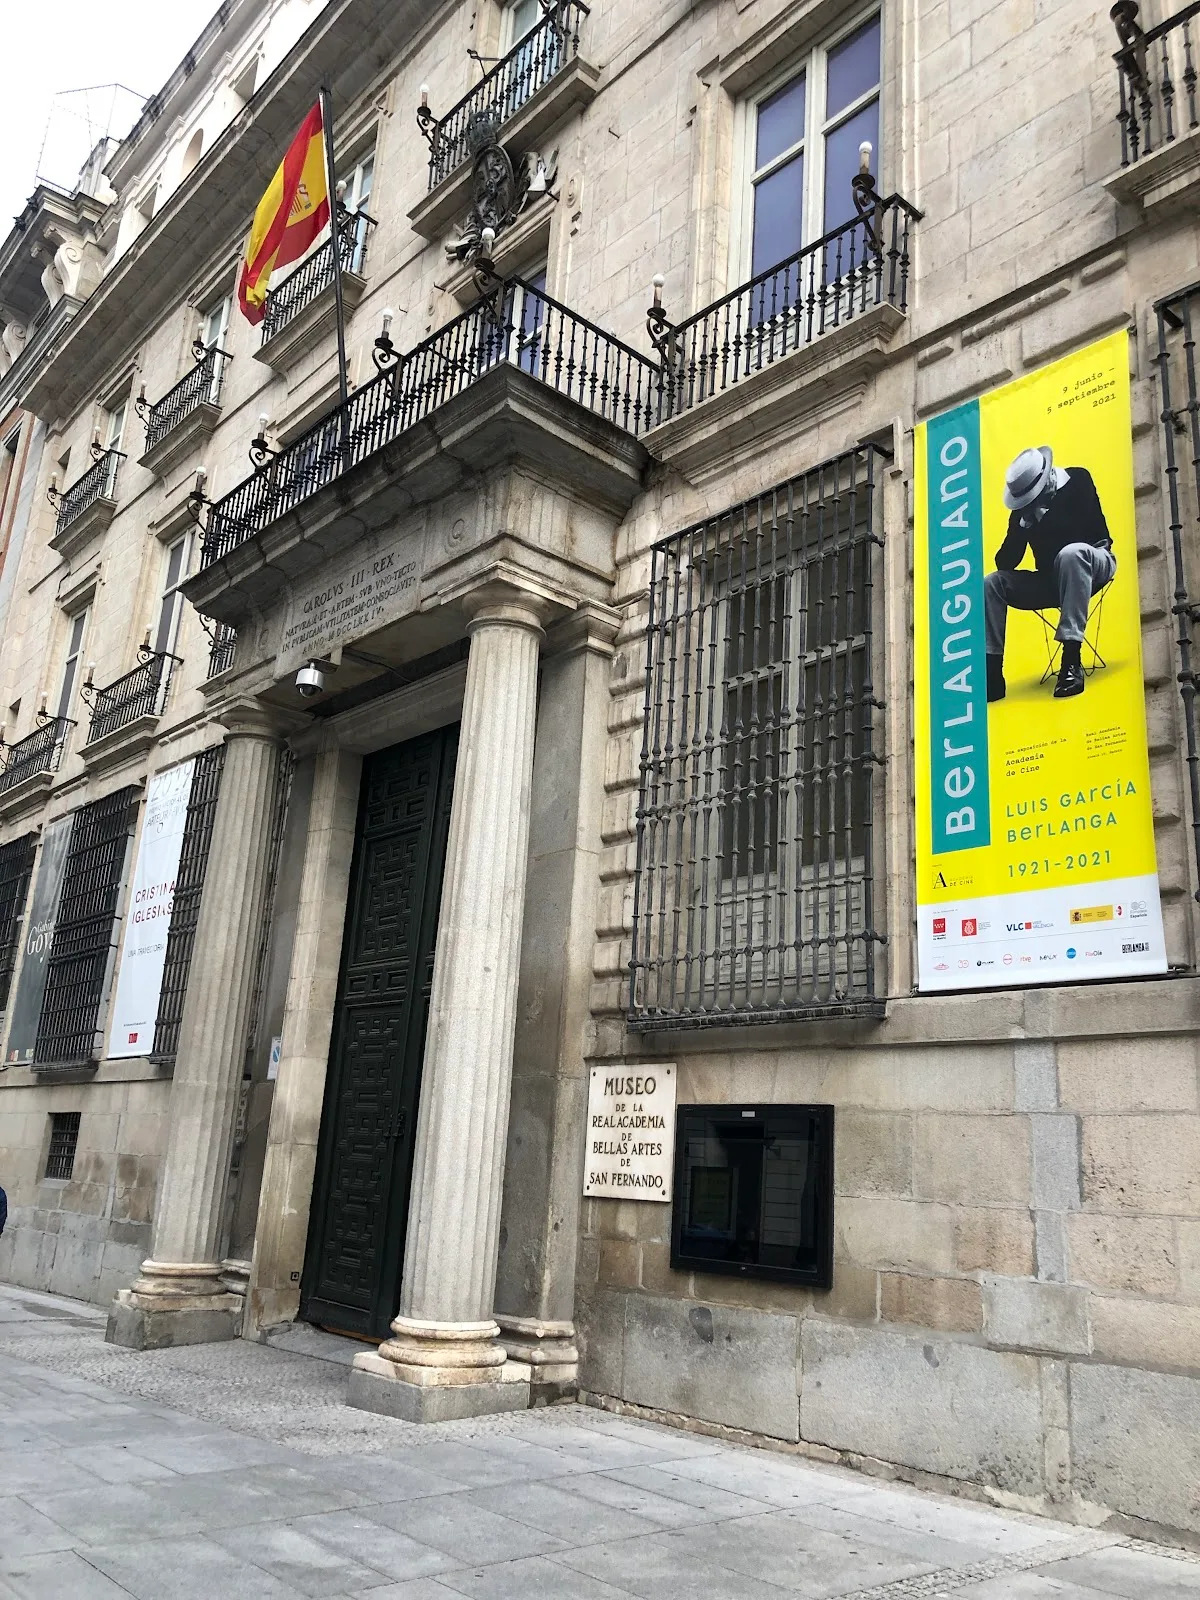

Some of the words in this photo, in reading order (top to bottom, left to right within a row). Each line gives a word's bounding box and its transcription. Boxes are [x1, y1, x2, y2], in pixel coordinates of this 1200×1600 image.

[1062, 386, 1068, 394] 9
[1074, 372, 1103, 390] junio
[1046, 406, 1052, 415] 5
[1057, 380, 1116, 409] septiembre
[1092, 393, 1117, 408] 2021
[393, 561, 417, 581] TECTO
[303, 582, 344, 613] CAROLVS
[350, 569, 366, 588] III
[371, 552, 395, 576] REX
[1005, 752, 1045, 766] Academia
[1006, 769, 1016, 777] de
[1020, 764, 1040, 774] Cine
[1006, 798, 1048, 817] LUIS
[135, 880, 175, 904] CRISTINA
[131, 901, 173, 925] IGLESIAS
[1006, 922, 1024, 932] VLC
[604, 1076, 657, 1096] MUSEO
[615, 1103, 626, 1112] DE
[633, 1103, 644, 1112] LA
[592, 1115, 616, 1128] REAL
[616, 1115, 666, 1129] ACADEMIA
[621, 1132, 633, 1141] DE
[593, 1141, 628, 1155] BELLAS
[631, 1142, 662, 1156] ARTES
[620, 1158, 631, 1167] DE
[589, 1172, 608, 1185] SAN
[611, 1173, 663, 1189] FERNANDO
